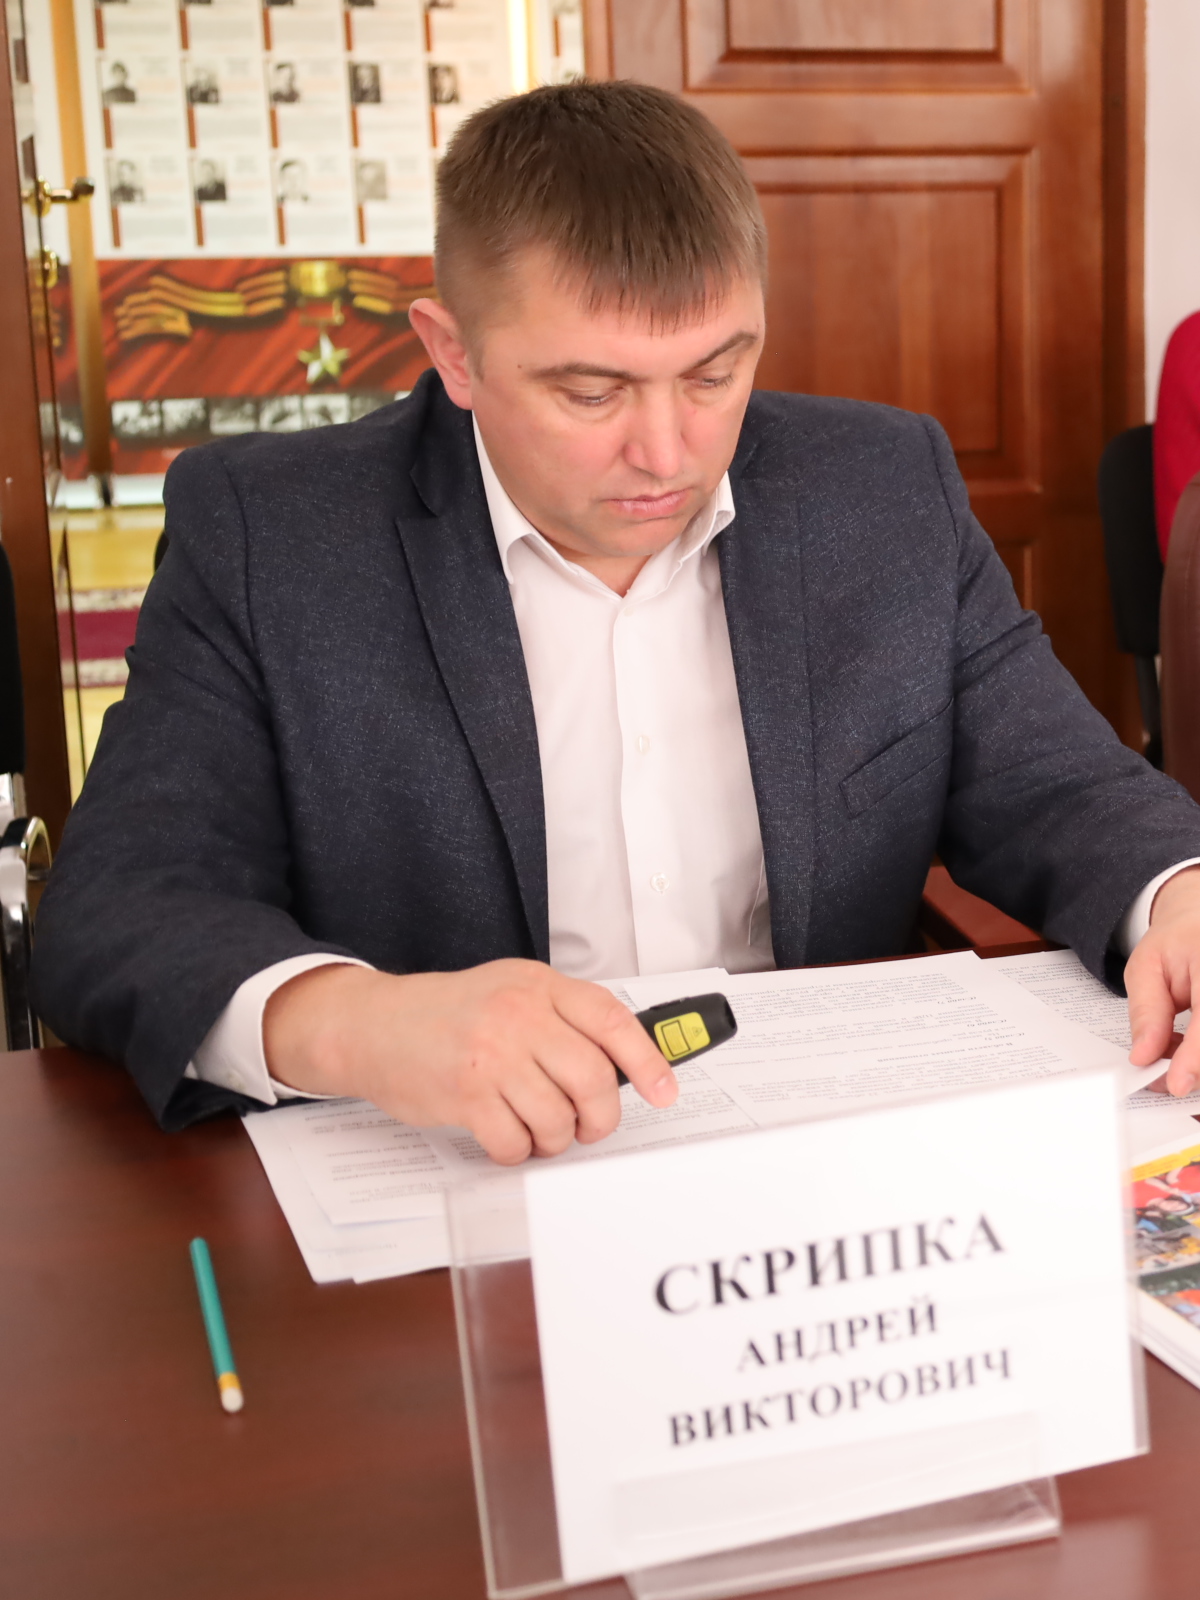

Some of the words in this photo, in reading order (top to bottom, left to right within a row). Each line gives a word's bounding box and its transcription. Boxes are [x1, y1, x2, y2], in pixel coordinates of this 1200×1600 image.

[654, 1213, 1005, 1316] СКРИПКА
[738, 1293, 938, 1372] АНДРЕЙ
[668, 1349, 1011, 1447] ВИКТОРОВИЧ
